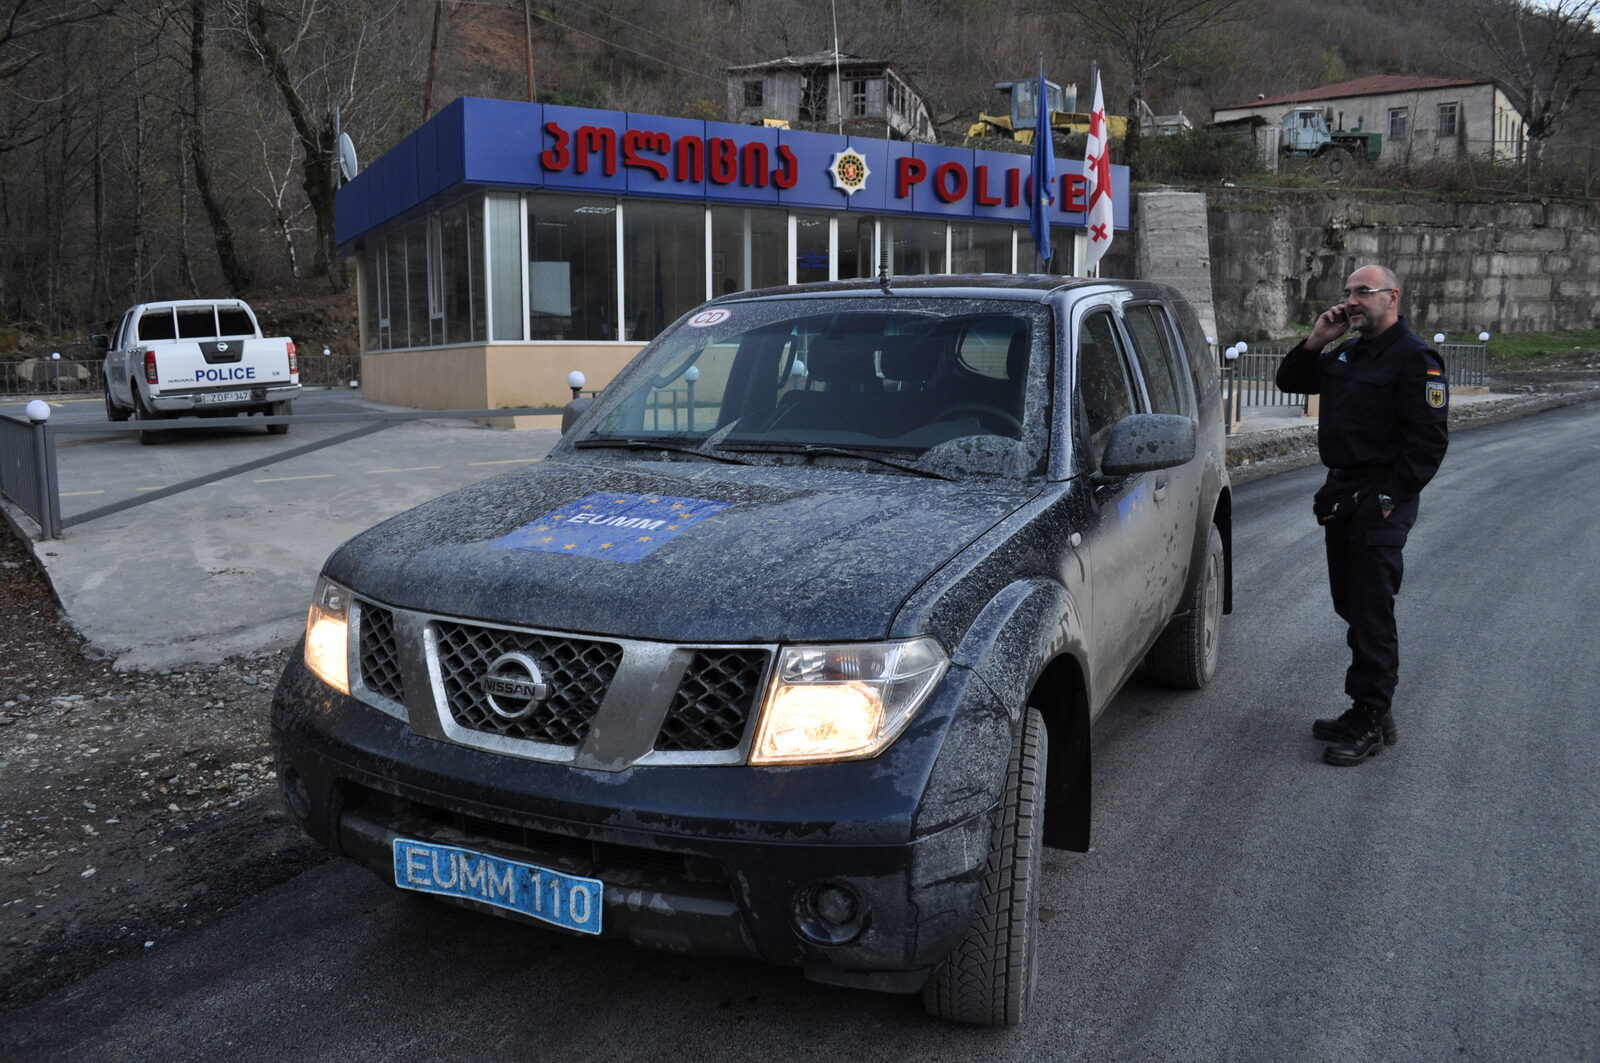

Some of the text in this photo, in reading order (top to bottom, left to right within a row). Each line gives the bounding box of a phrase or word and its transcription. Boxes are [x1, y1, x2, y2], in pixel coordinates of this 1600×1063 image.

[541, 122, 798, 189] პოლიცია
[694, 312, 725, 323] CD
[195, 367, 256, 382] POLICE
[567, 513, 667, 530] EUMM
[484, 679, 536, 696] NISSAN
[406, 847, 590, 924] EUMM 110
